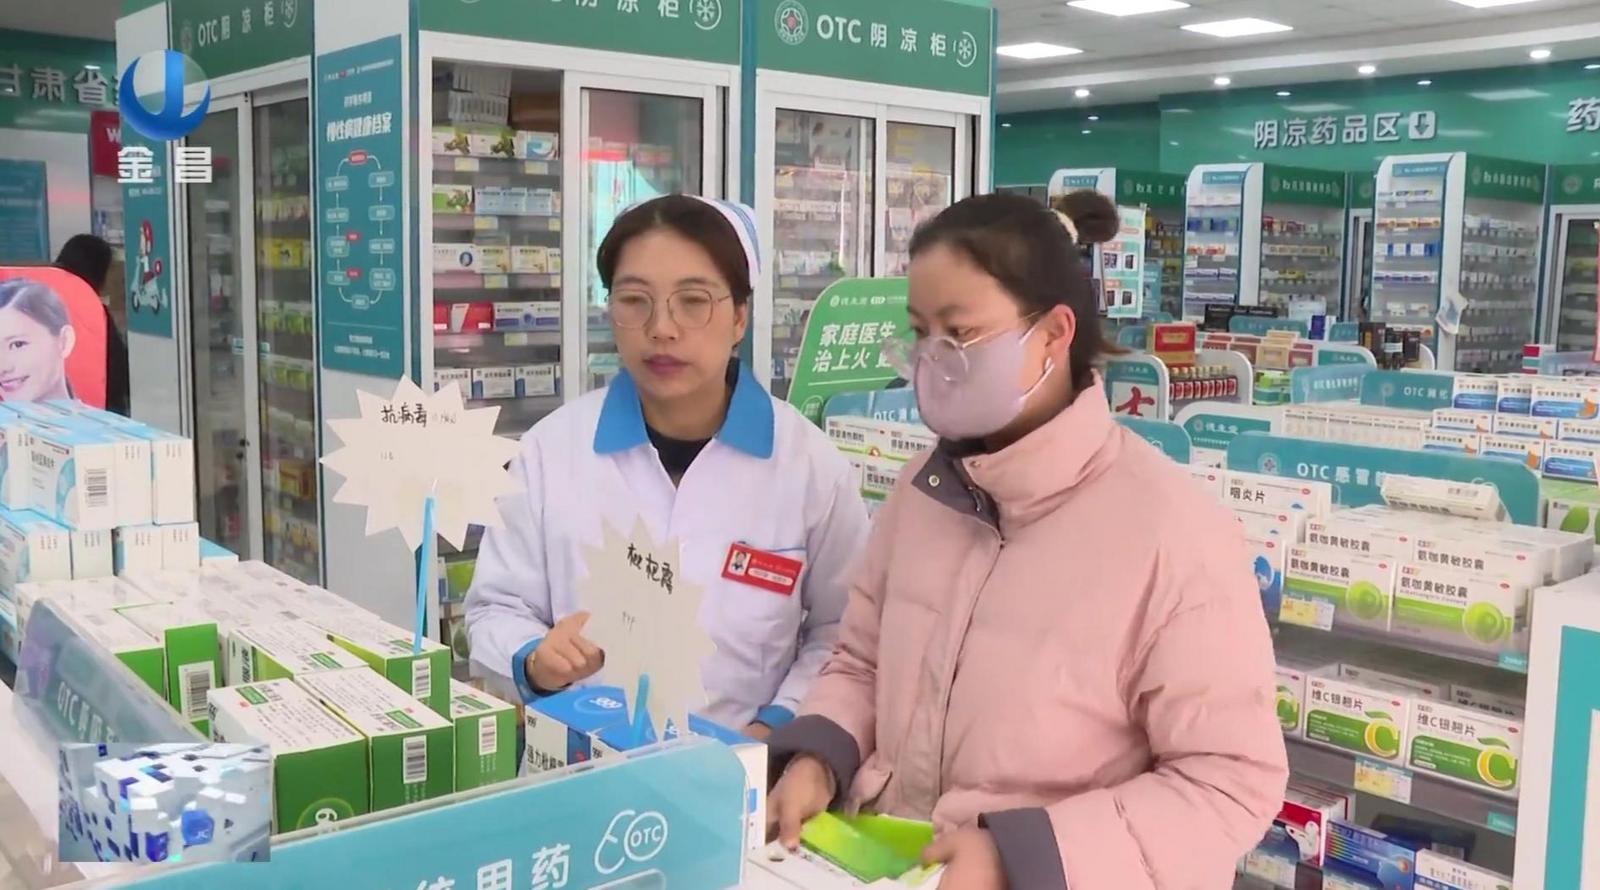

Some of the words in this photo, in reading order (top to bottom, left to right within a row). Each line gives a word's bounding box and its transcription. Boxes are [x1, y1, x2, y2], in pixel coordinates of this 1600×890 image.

[199, 19, 218, 47] OTC
[816, 14, 861, 43] OTC
[870, 22, 946, 57] 阴凉柜
[0, 63, 108, 104] 甘肃省
[1254, 112, 1402, 148] 阴凉药品区
[819, 321, 896, 347] 家庭医生
[811, 347, 871, 372] 治上火
[380, 401, 428, 428] 抗病毒
[1297, 462, 1330, 480] OTC
[1229, 486, 1265, 504] 咽炎片
[1309, 532, 1370, 552] 氨咖黄敏胶囊
[627, 543, 674, 595] 枇杷露
[1291, 557, 1350, 578] 氨咖黄敏胶囊
[1417, 549, 1485, 570] 氨咖黄敏胶囊
[1400, 576, 1468, 598] 氨咖黄敏胶囊
[630, 825, 662, 848] OTC
